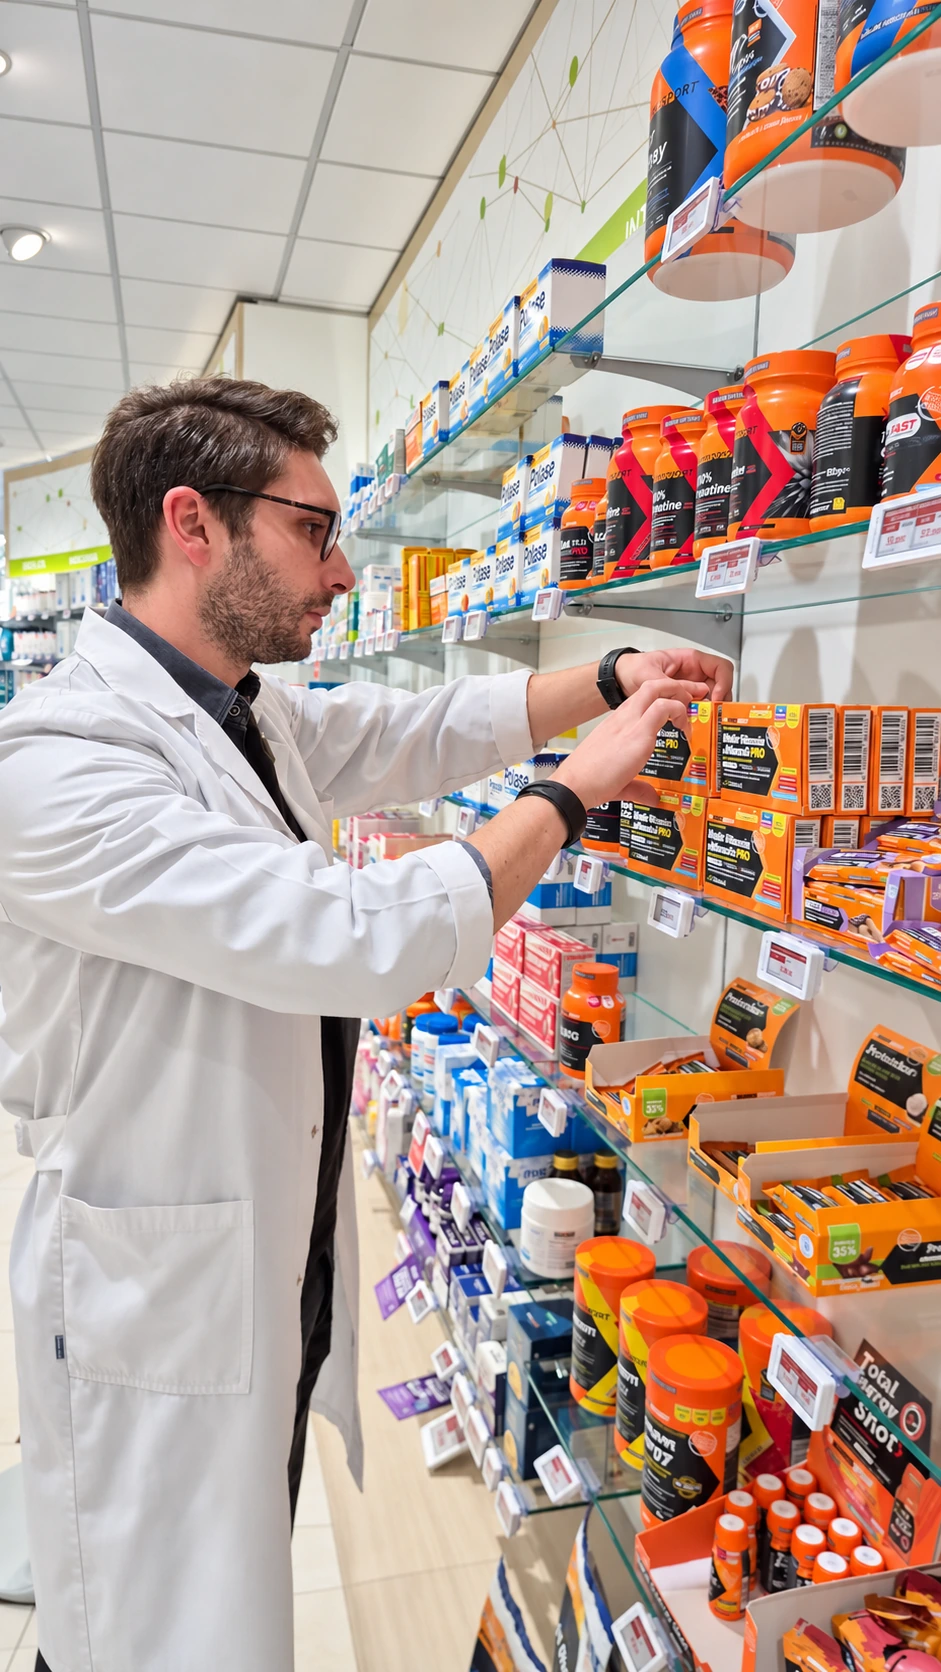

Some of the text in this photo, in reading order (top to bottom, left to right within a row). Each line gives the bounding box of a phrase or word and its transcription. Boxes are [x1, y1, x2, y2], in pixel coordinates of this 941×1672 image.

[625, 202, 647, 241] INT
[530, 461, 555, 488] Polase
[502, 480, 520, 503] Polase
[495, 555, 514, 575] Polase
[524, 543, 547, 567] Polase
[832, 1246, 857, 1258] 35%
